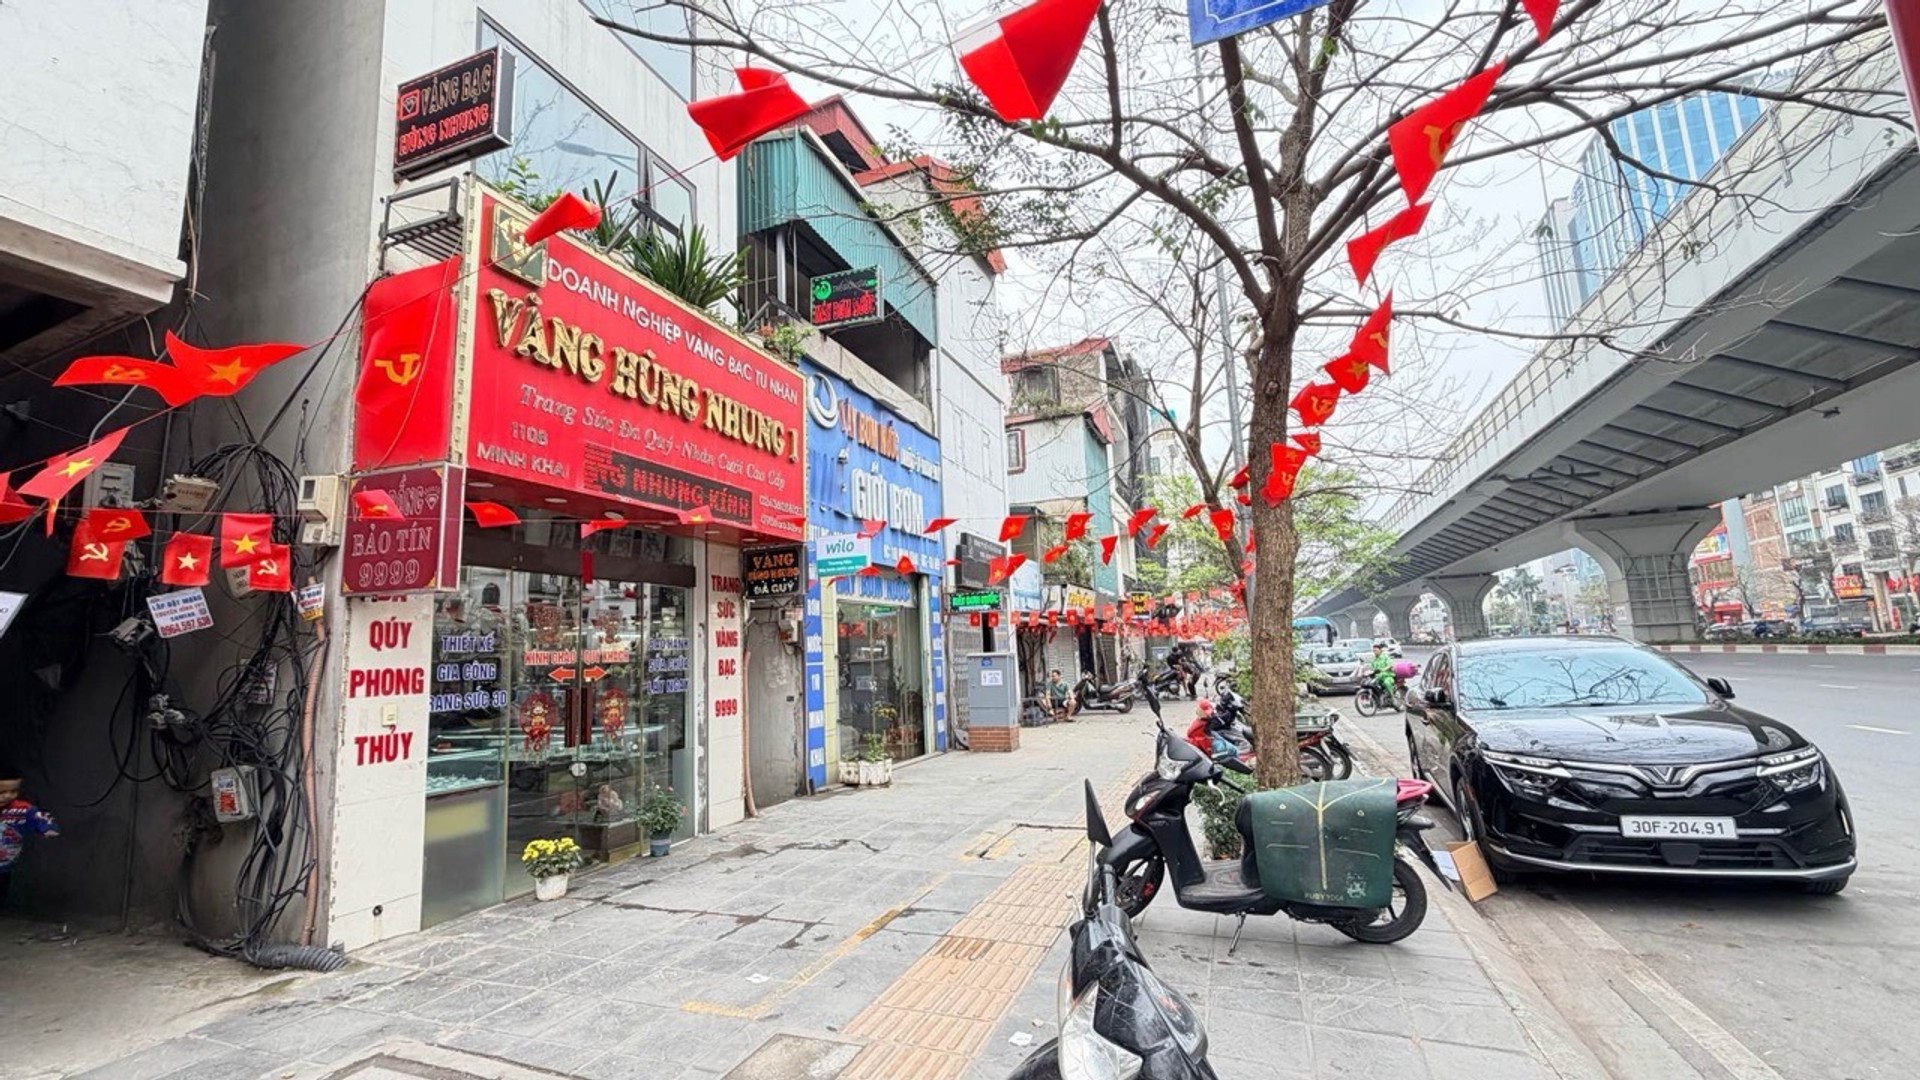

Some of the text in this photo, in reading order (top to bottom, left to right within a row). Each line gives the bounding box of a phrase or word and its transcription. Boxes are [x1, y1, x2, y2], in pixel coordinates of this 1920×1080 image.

[421, 64, 491, 116] VÀNG BẠC
[439, 104, 489, 140] NHUNG
[549, 258, 618, 313] DOANH
[624, 295, 681, 345] NGHIỆP
[685, 330, 724, 367] VÀNG
[728, 354, 752, 381] BẠC
[487, 288, 799, 464] VÀNG HÙNG NHUNG 1
[520, 384, 577, 425] Trang
[747, 464, 766, 482] Cao
[477, 441, 570, 480] MINH KHAI
[633, 468, 705, 508] NHUNG
[352, 521, 433, 556] BẢO TÍN
[826, 540, 855, 555] wilo
[359, 559, 420, 588] 9999
[752, 552, 795, 569] VÀNG
[711, 575, 741, 594] TRANG
[717, 598, 735, 618] SỨC
[441, 631, 495, 653] THIẾT KẾ
[715, 626, 738, 647] VÀNG
[437, 660, 497, 682] GIA CÔNG
[718, 659, 736, 679] BẠC
[349, 668, 424, 698] PHONG
[463, 685, 490, 709] SỨC
[492, 690, 508, 708] 3D
[715, 699, 737, 717] 9999
[354, 724, 413, 766] THỦY
[1631, 820, 1725, 835] 30F-204.91
